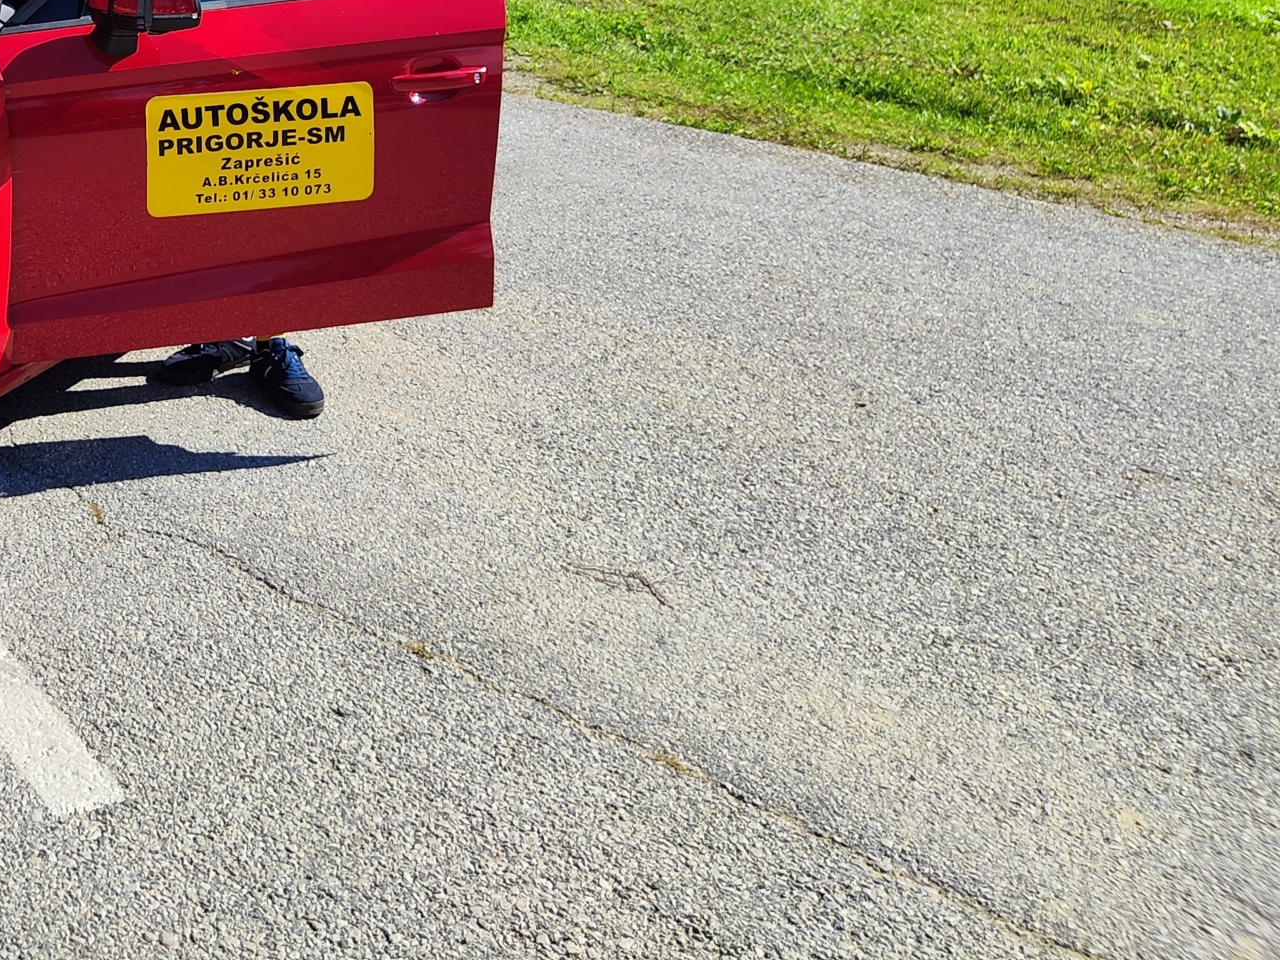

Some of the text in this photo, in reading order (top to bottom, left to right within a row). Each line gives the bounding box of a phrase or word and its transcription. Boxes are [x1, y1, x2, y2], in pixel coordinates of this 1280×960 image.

[157, 95, 362, 132] AUTOŠKOLA
[158, 125, 346, 157] PRIGORJE-SM
[220, 152, 301, 172] Zaprešić
[201, 168, 322, 188] A.B.Krčelića 15
[195, 192, 228, 205] Tel.:
[258, 188, 277, 200] 33
[282, 186, 300, 198] 10
[304, 183, 332, 195] 073
